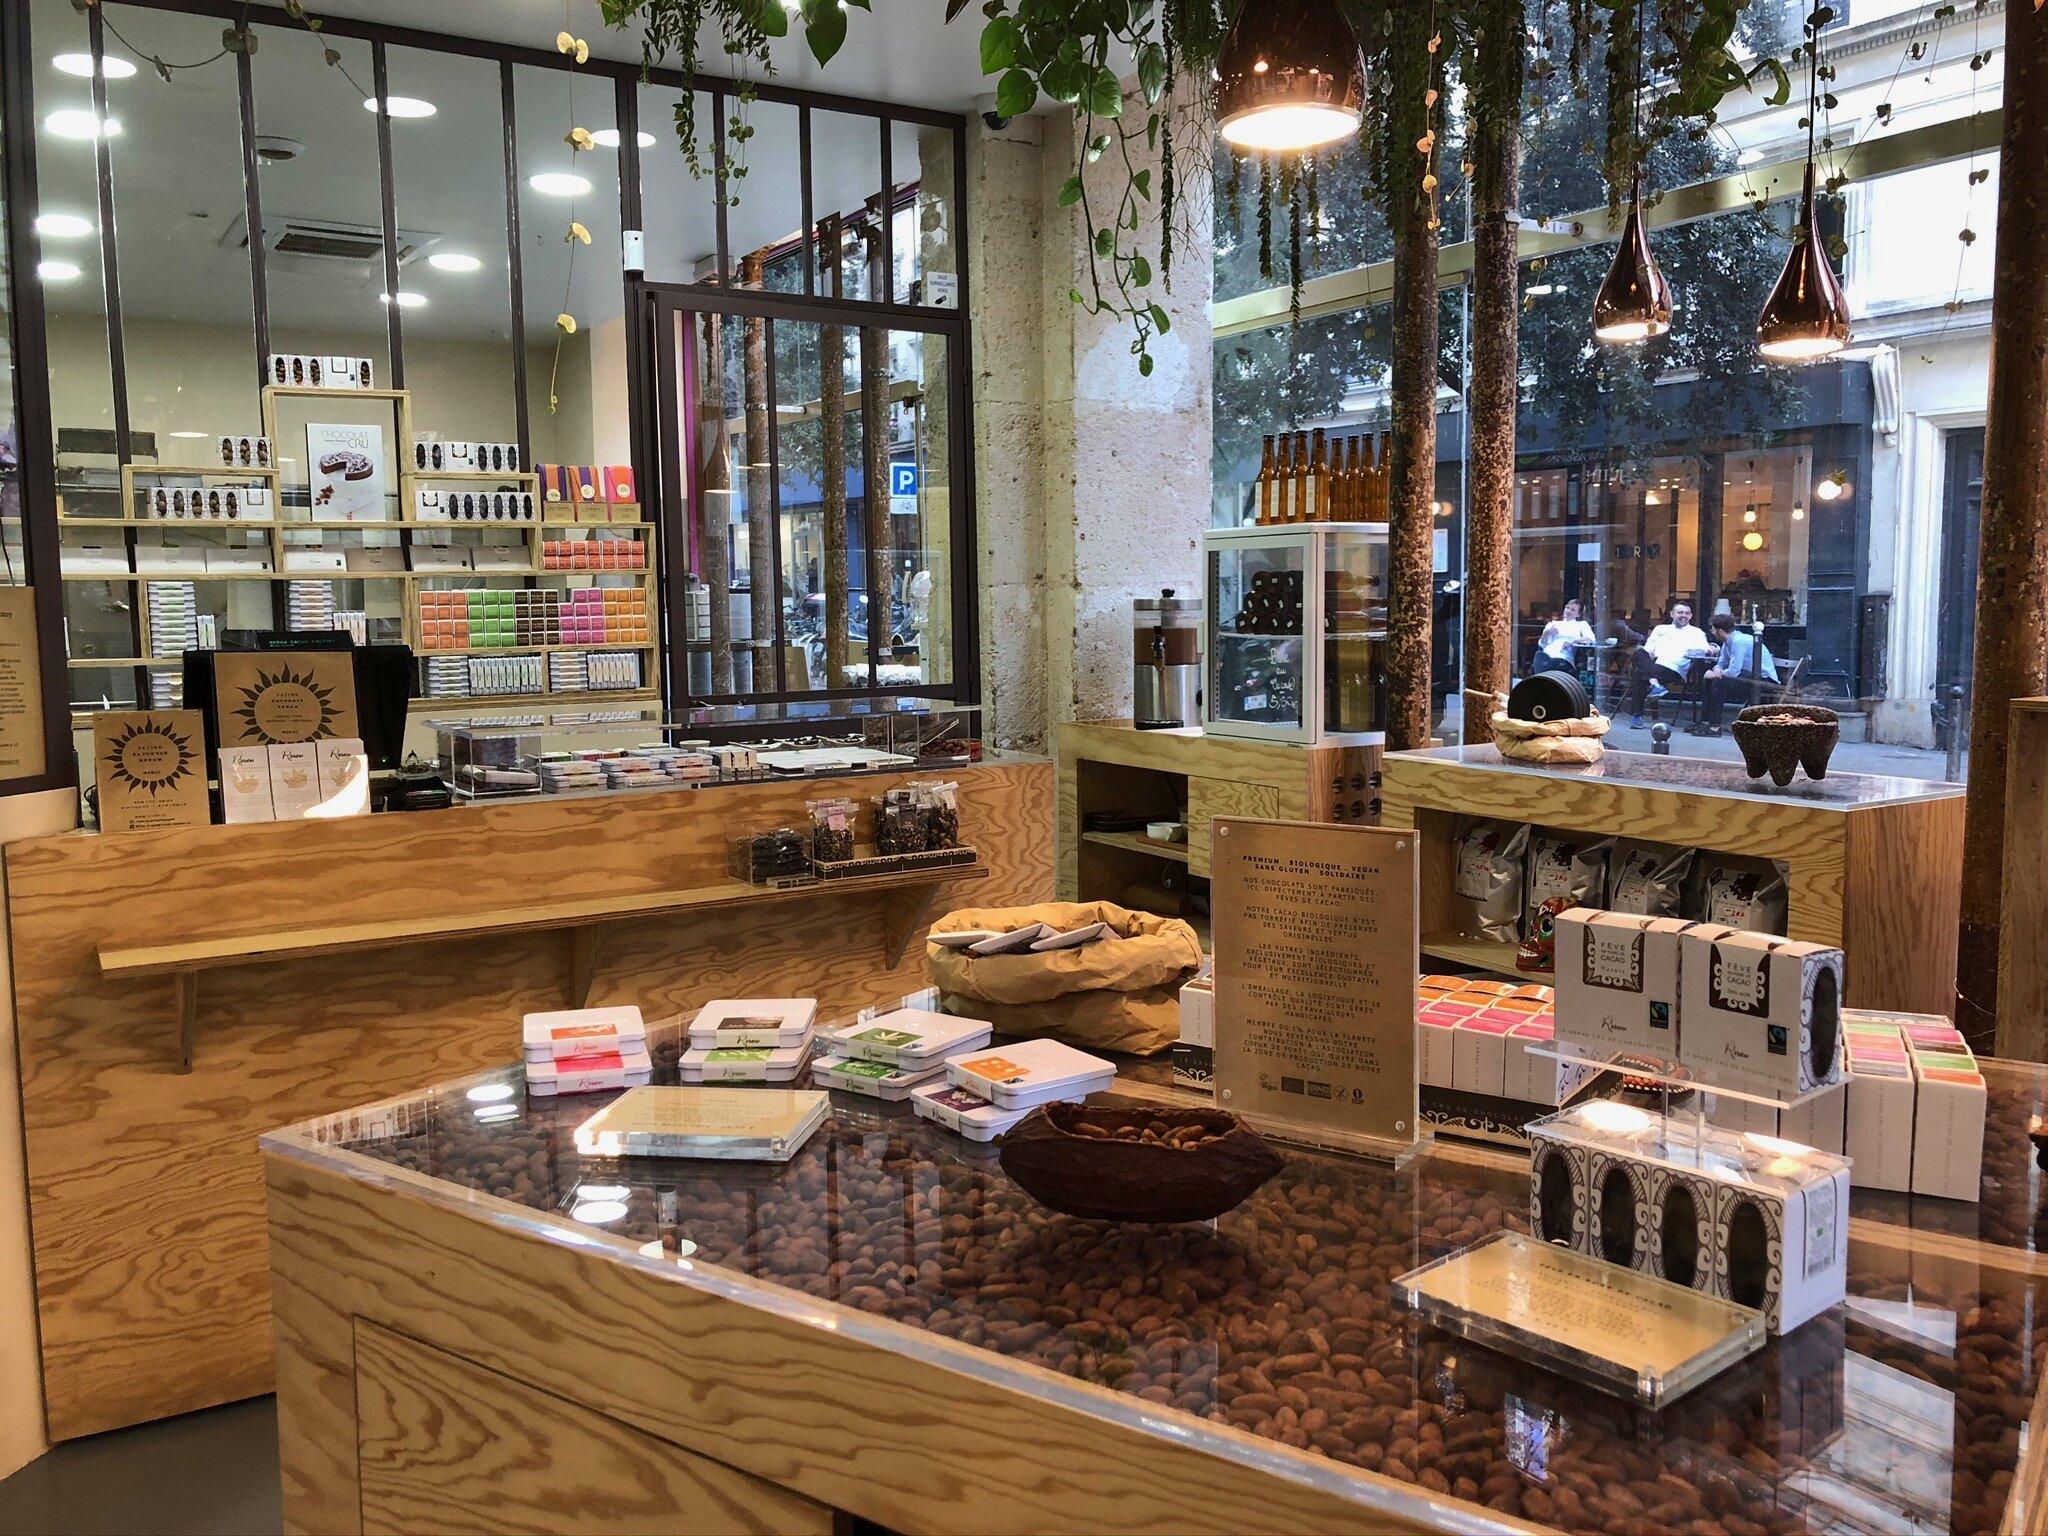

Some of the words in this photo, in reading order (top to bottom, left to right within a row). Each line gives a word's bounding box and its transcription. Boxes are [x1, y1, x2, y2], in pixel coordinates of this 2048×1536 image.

[348, 439, 368, 448] CRU
[900, 470, 914, 490] P
[1242, 856, 1280, 864] PREMIUM
[1290, 860, 1341, 870] BIOLOGIQUE
[1279, 866, 1310, 874] GLUTEN
[1320, 870, 1366, 880] SOLIDAIRE
[1261, 879, 1305, 888] CHOCOLATS
[1265, 886, 1316, 897] DIRECTEMENT
[1328, 892, 1356, 900] PARTIR
[1274, 908, 1297, 917] CACAO
[1301, 912, 1349, 923] BIOLOGIQUE
[1263, 921, 1276, 929] SES
[1280, 924, 1312, 933] SAVEURS
[1329, 930, 1357, 939] VERTUS
[1275, 945, 1303, 954] AUTRES
[1246, 949, 1306, 960] EXCLUSIVEMENT
[1310, 956, 1362, 969] BIOLOGIQUES
[1292, 961, 1312, 969] SONT
[1600, 954, 1625, 963] CACAO
[1243, 962, 1262, 970] POUR
[1287, 968, 1333, 979] EXCELLENCE
[1337, 974, 1379, 985] GUSTATIVE
[1727, 976, 1751, 986] CACAO
[1308, 992, 1354, 1004] LOGISTIQUE
[1326, 1001, 1345, 1009] SONT
[1300, 1006, 1355, 1019] TRAVAILLEURS
[1246, 1019, 1276, 1028] MEMBRE
[1306, 1028, 1327, 1036] POUR
[1249, 1033, 1303, 1047] CONTRIBUTION
[1286, 1032, 1329, 1044] REVERSONS
[1333, 1040, 1358, 1048] NOTRE
[1254, 1049, 1273, 1057] ZONE
[1289, 1054, 1338, 1067] PRODUCTION
[1355, 1064, 1380, 1074] NOTRE
[1358, 1058, 1379, 1066] DANS
